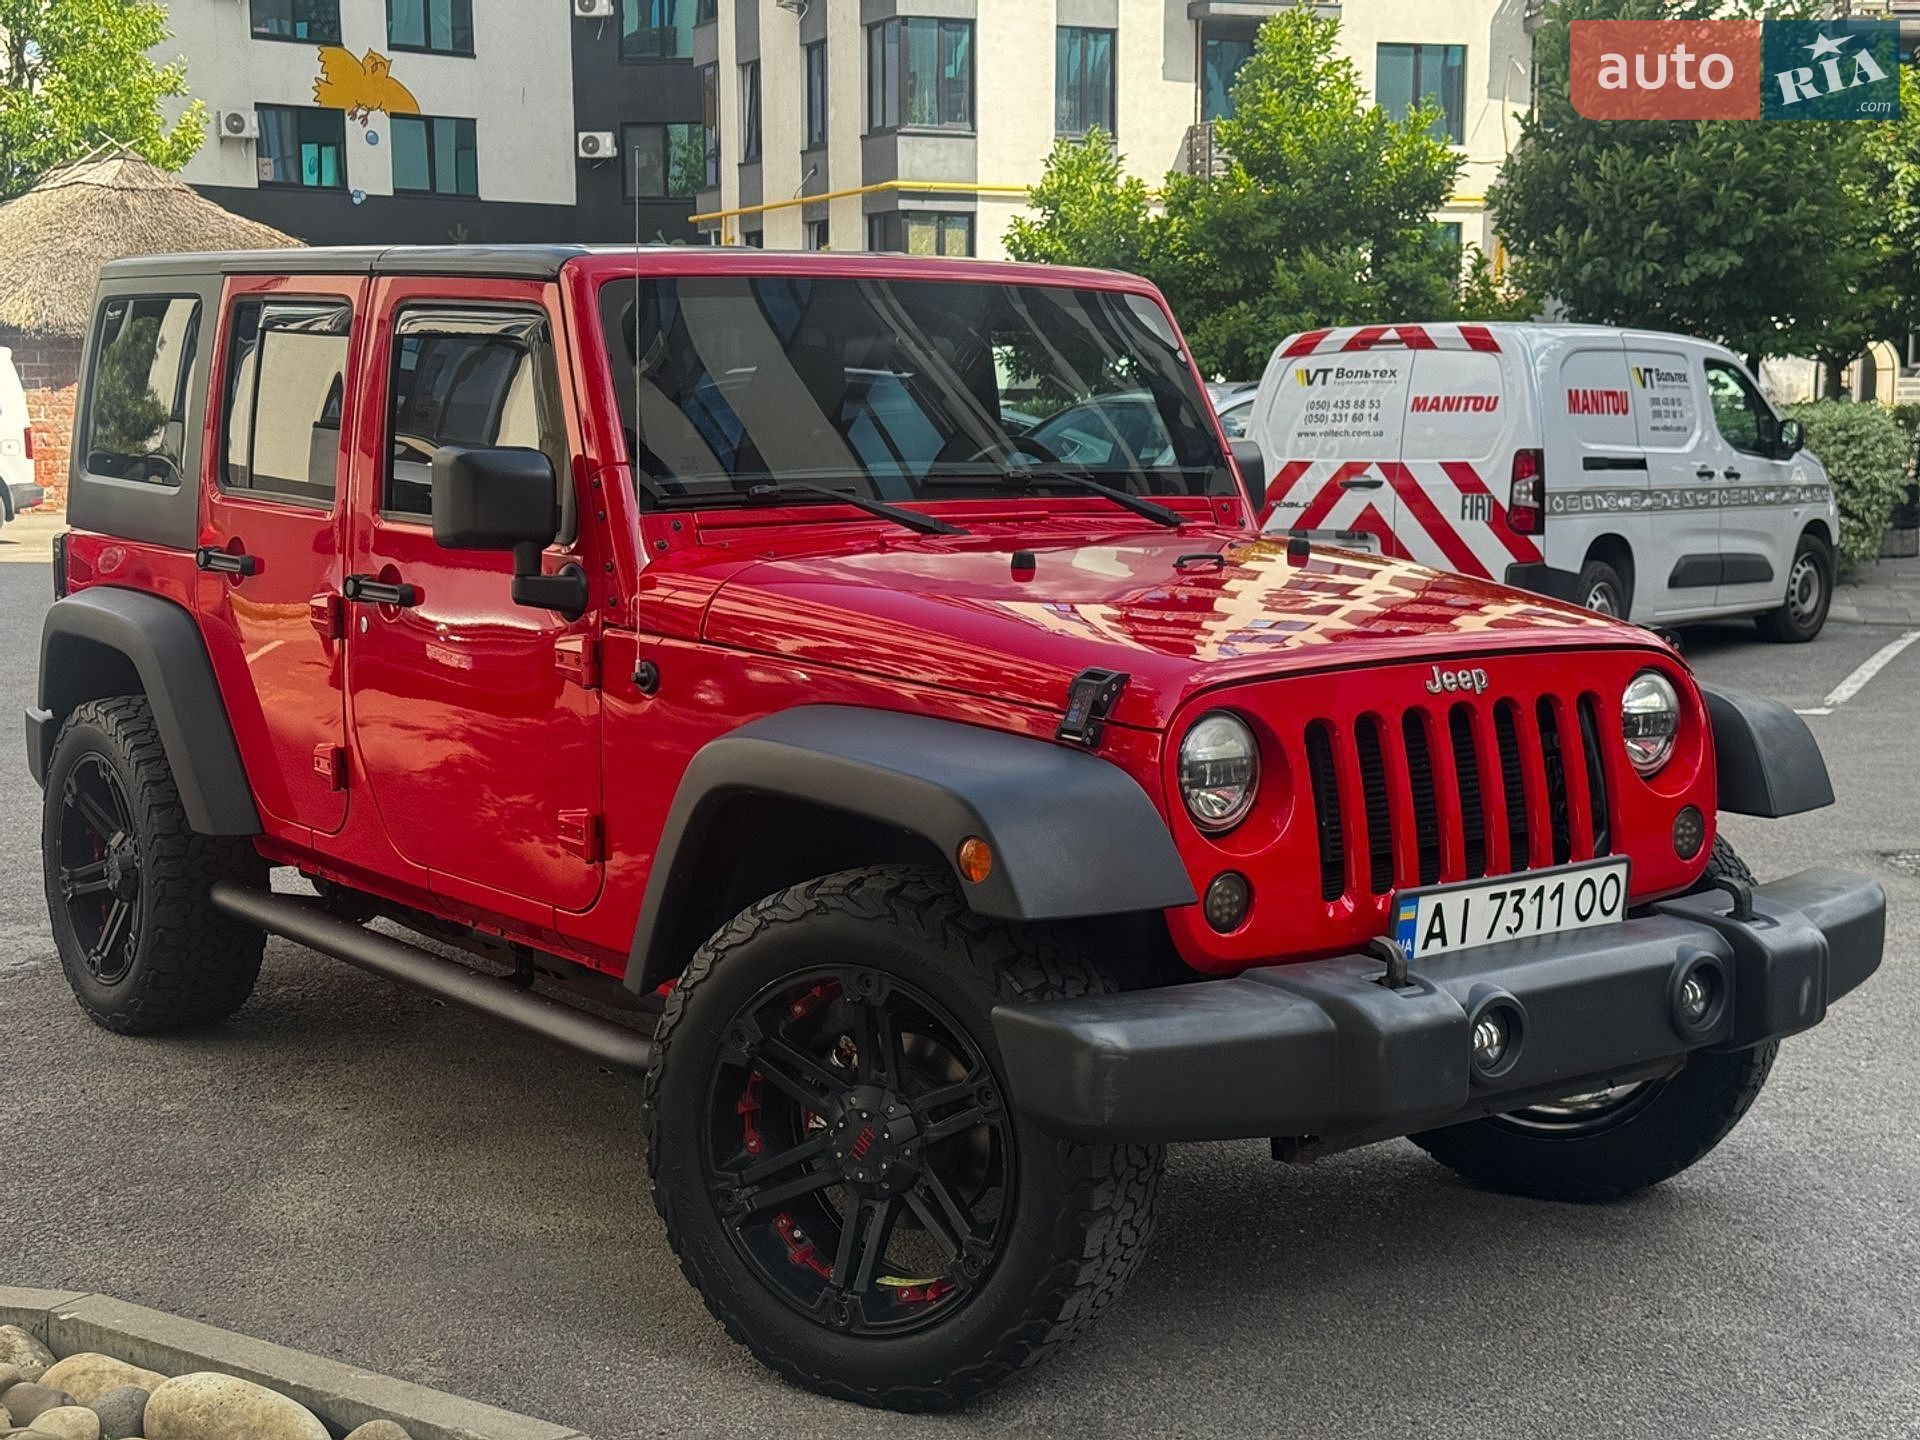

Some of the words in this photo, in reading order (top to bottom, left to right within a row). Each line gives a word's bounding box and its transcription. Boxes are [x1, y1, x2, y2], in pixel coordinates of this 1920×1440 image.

[1304, 368, 1334, 386] VT
[1335, 367, 1398, 379] Вольтех
[1305, 400, 1331, 412] (050)
[1410, 396, 1500, 413] MANITOU
[1567, 388, 1629, 417] MANITOU
[1304, 413, 1329, 425] (050)
[1461, 493, 1496, 521] FIAT
[1425, 665, 1489, 695] Jeep
[1421, 897, 1470, 951] AI
[1486, 881, 1566, 939] 7311
